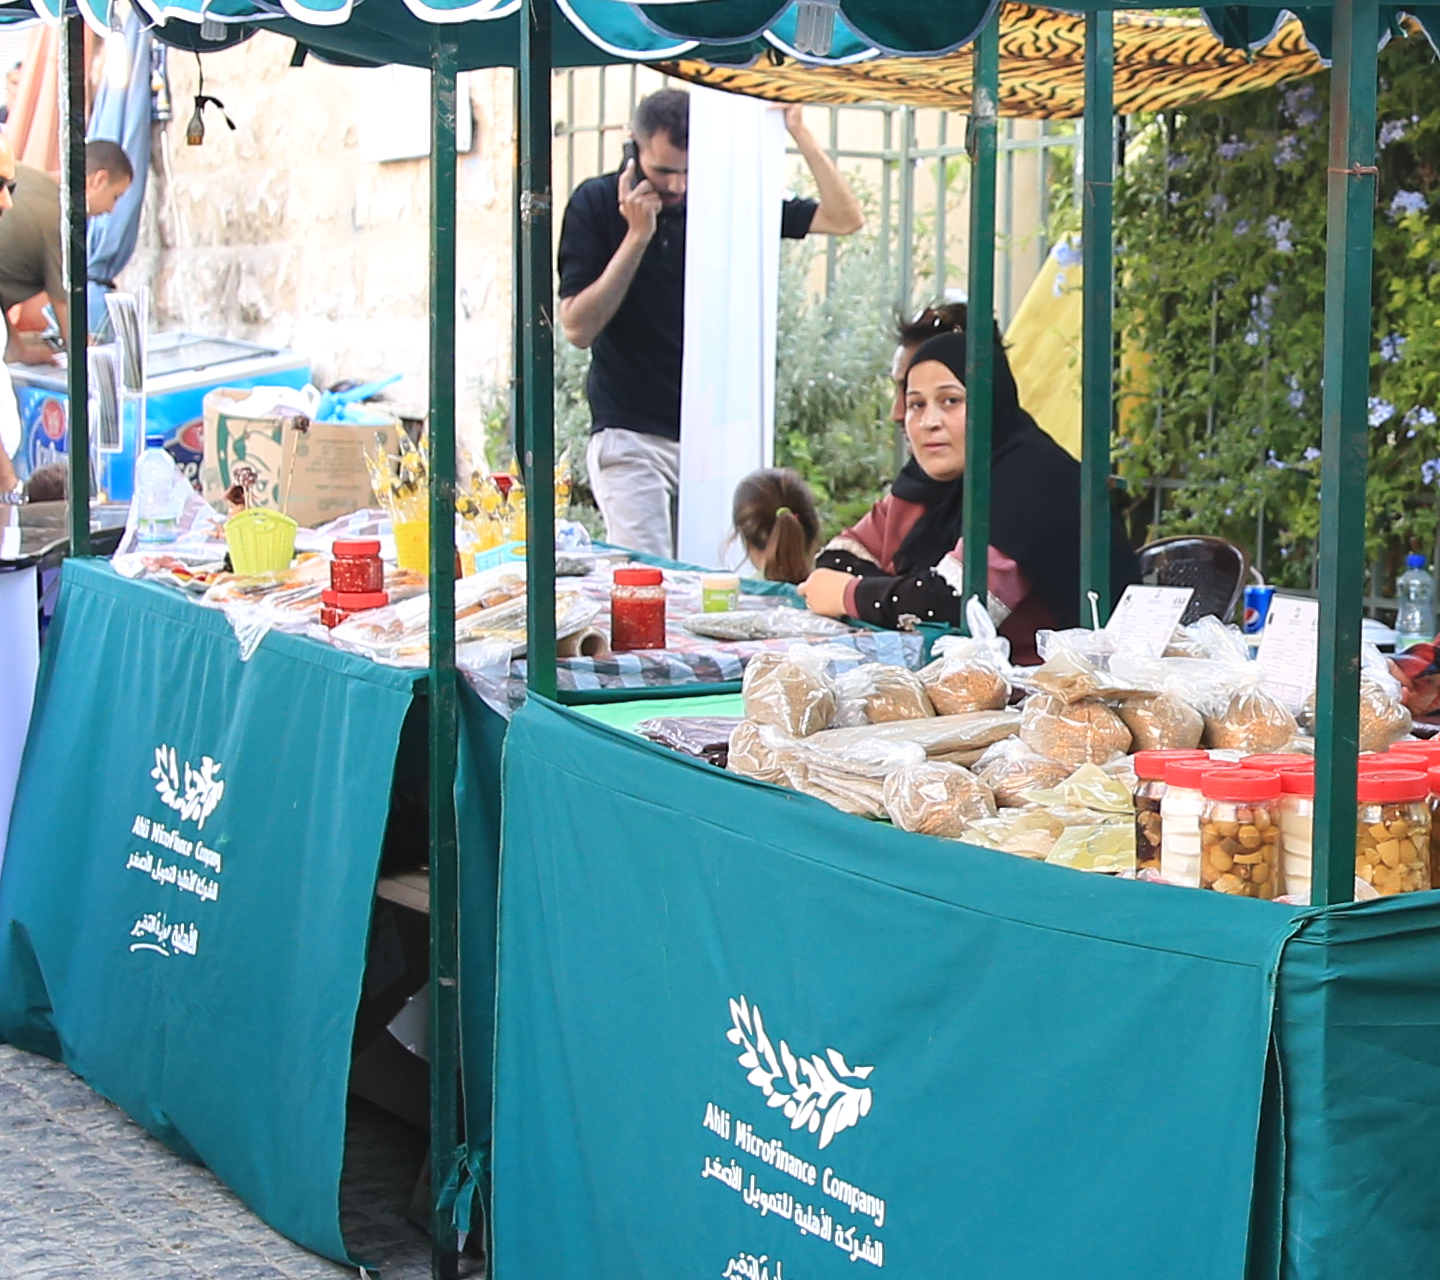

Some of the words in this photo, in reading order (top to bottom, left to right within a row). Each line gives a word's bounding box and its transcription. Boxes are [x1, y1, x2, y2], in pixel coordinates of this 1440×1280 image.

[702, 1157, 742, 1191] الأصغر
[703, 1102, 730, 1140] Ahli
[735, 1120, 816, 1186] Microfinance
[823, 1167, 884, 1227] Company
[743, 1175, 793, 1219] للتمويل
[794, 1203, 832, 1241] الأهلية
[834, 1224, 883, 1267] الشركة
